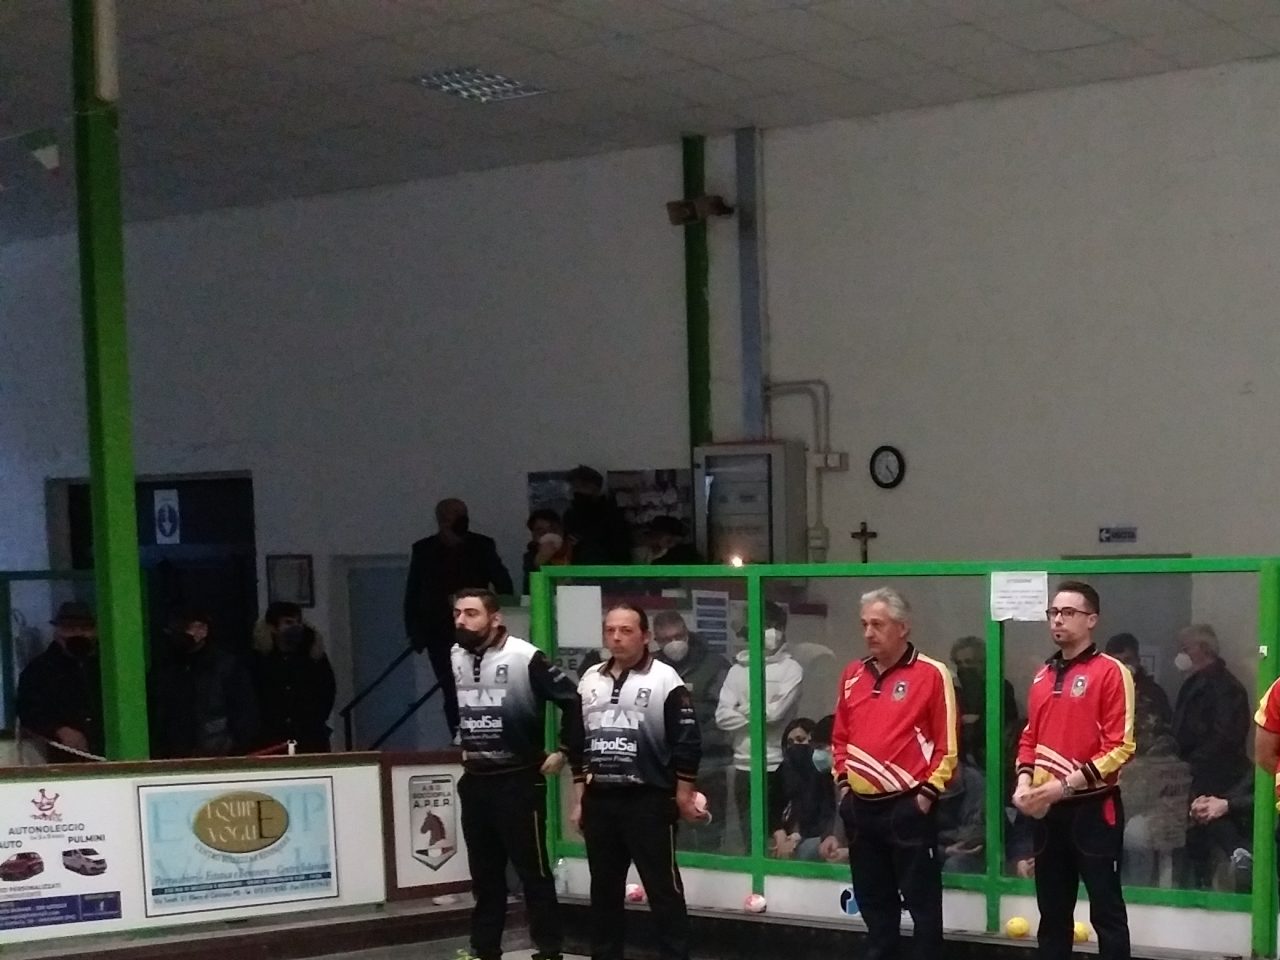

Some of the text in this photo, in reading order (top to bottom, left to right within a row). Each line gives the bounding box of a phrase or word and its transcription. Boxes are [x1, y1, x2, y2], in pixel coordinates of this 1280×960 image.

[590, 737, 638, 754] UnipolSai
[8, 823, 85, 836] AUTONOLEGGIO
[68, 834, 106, 844] PULMINI
